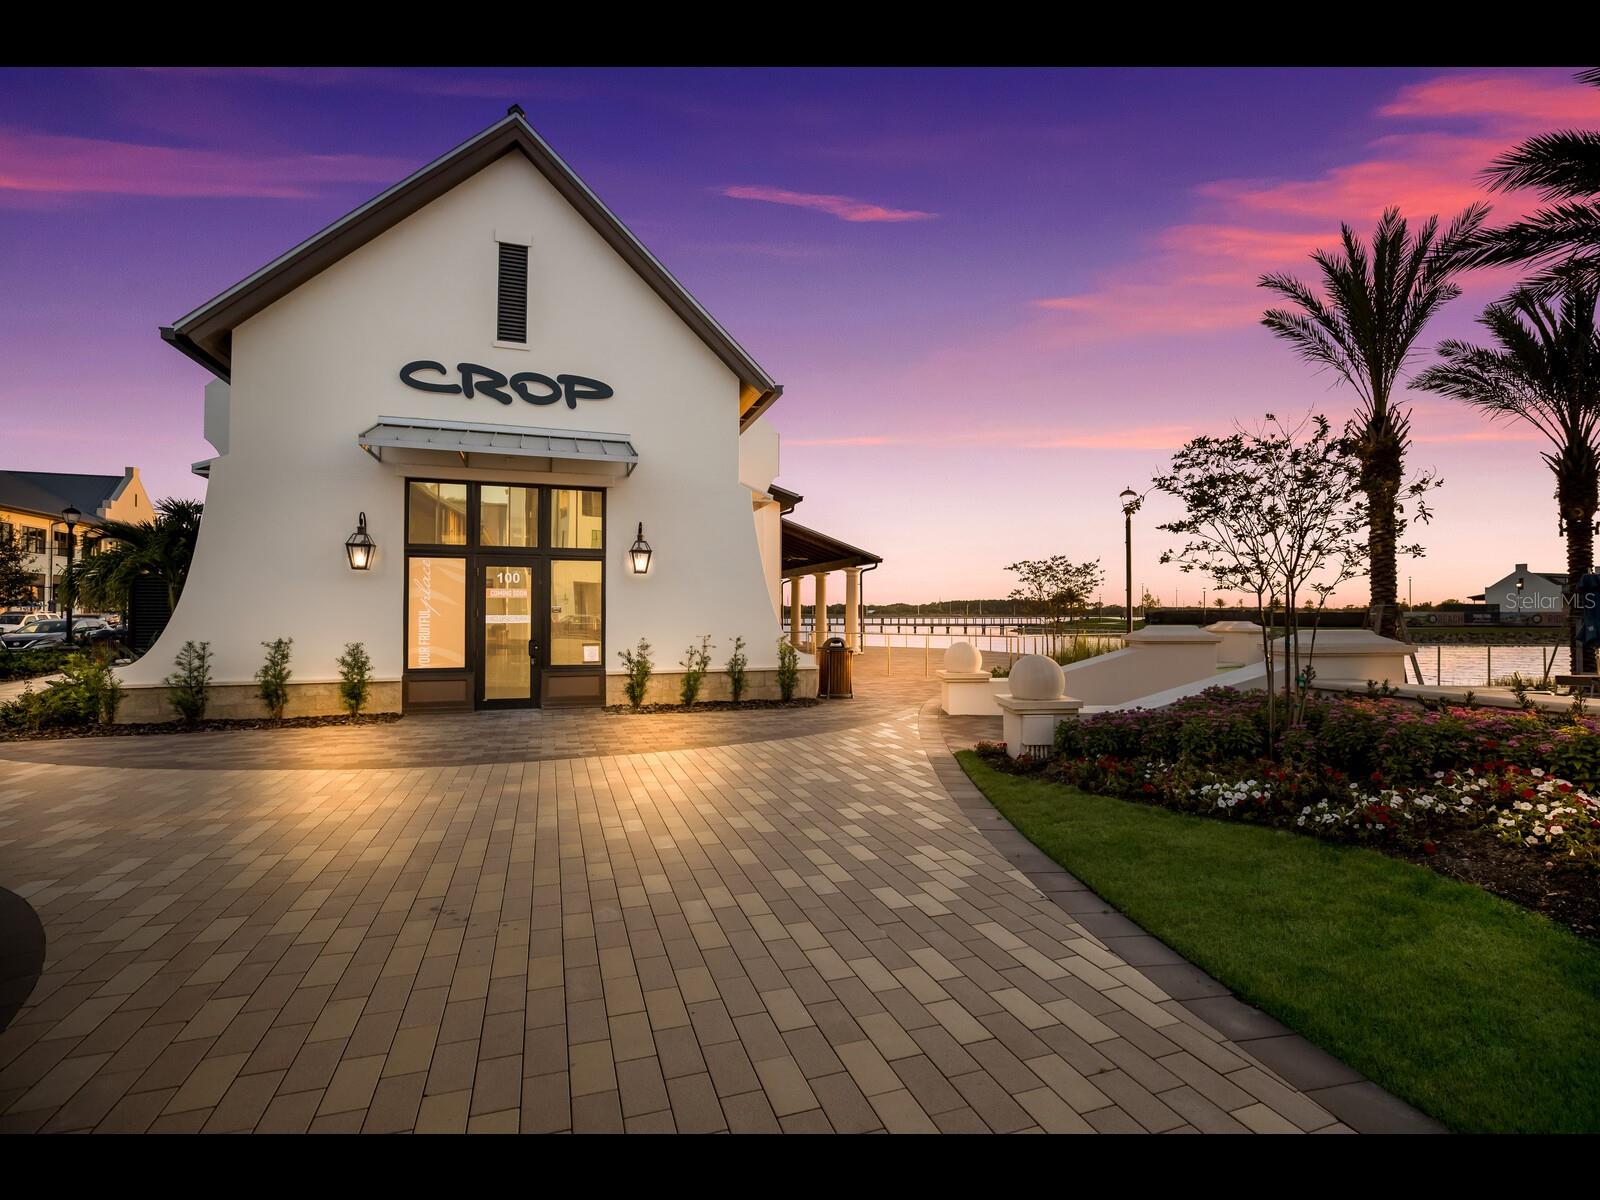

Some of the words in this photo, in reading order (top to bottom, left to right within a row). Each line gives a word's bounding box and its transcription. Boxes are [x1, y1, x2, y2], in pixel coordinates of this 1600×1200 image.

[399, 360, 614, 410] CROP
[496, 572, 520, 584] 100
[490, 589, 512, 597] COMING
[418, 609, 431, 646] FRUITFUL
[418, 647, 431, 668] YOUR
